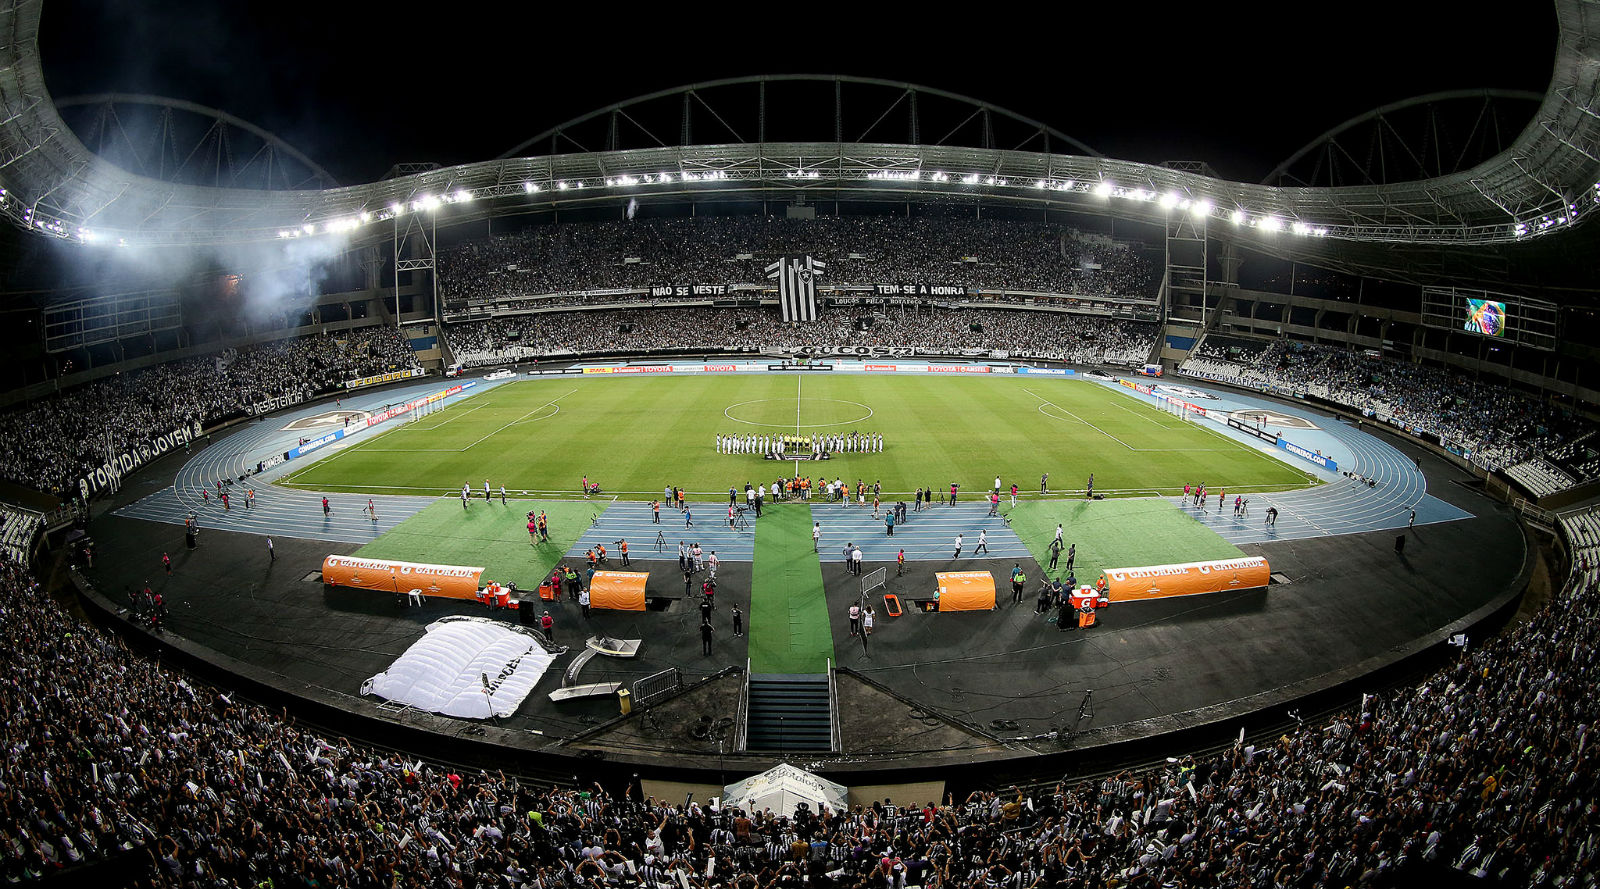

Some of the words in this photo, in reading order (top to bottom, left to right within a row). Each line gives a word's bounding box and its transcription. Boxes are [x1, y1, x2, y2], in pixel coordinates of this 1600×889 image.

[676, 287, 689, 296] SE
[693, 285, 725, 295] VESTE
[877, 285, 916, 294] TEM-SE
[931, 286, 964, 295] HONRA
[368, 411, 390, 426] TOYOTA
[88, 449, 142, 492] TORCIDA
[152, 426, 193, 456] JOVEM
[1285, 442, 1327, 466] CONMEBOL.COM
[340, 559, 390, 571] GATORADE
[415, 567, 475, 578] GATORADE
[1129, 567, 1189, 579] GATORADE
[1213, 560, 1265, 571] GATORADE
[1081, 598, 1091, 608] G
[886, 807, 894, 817] 13
